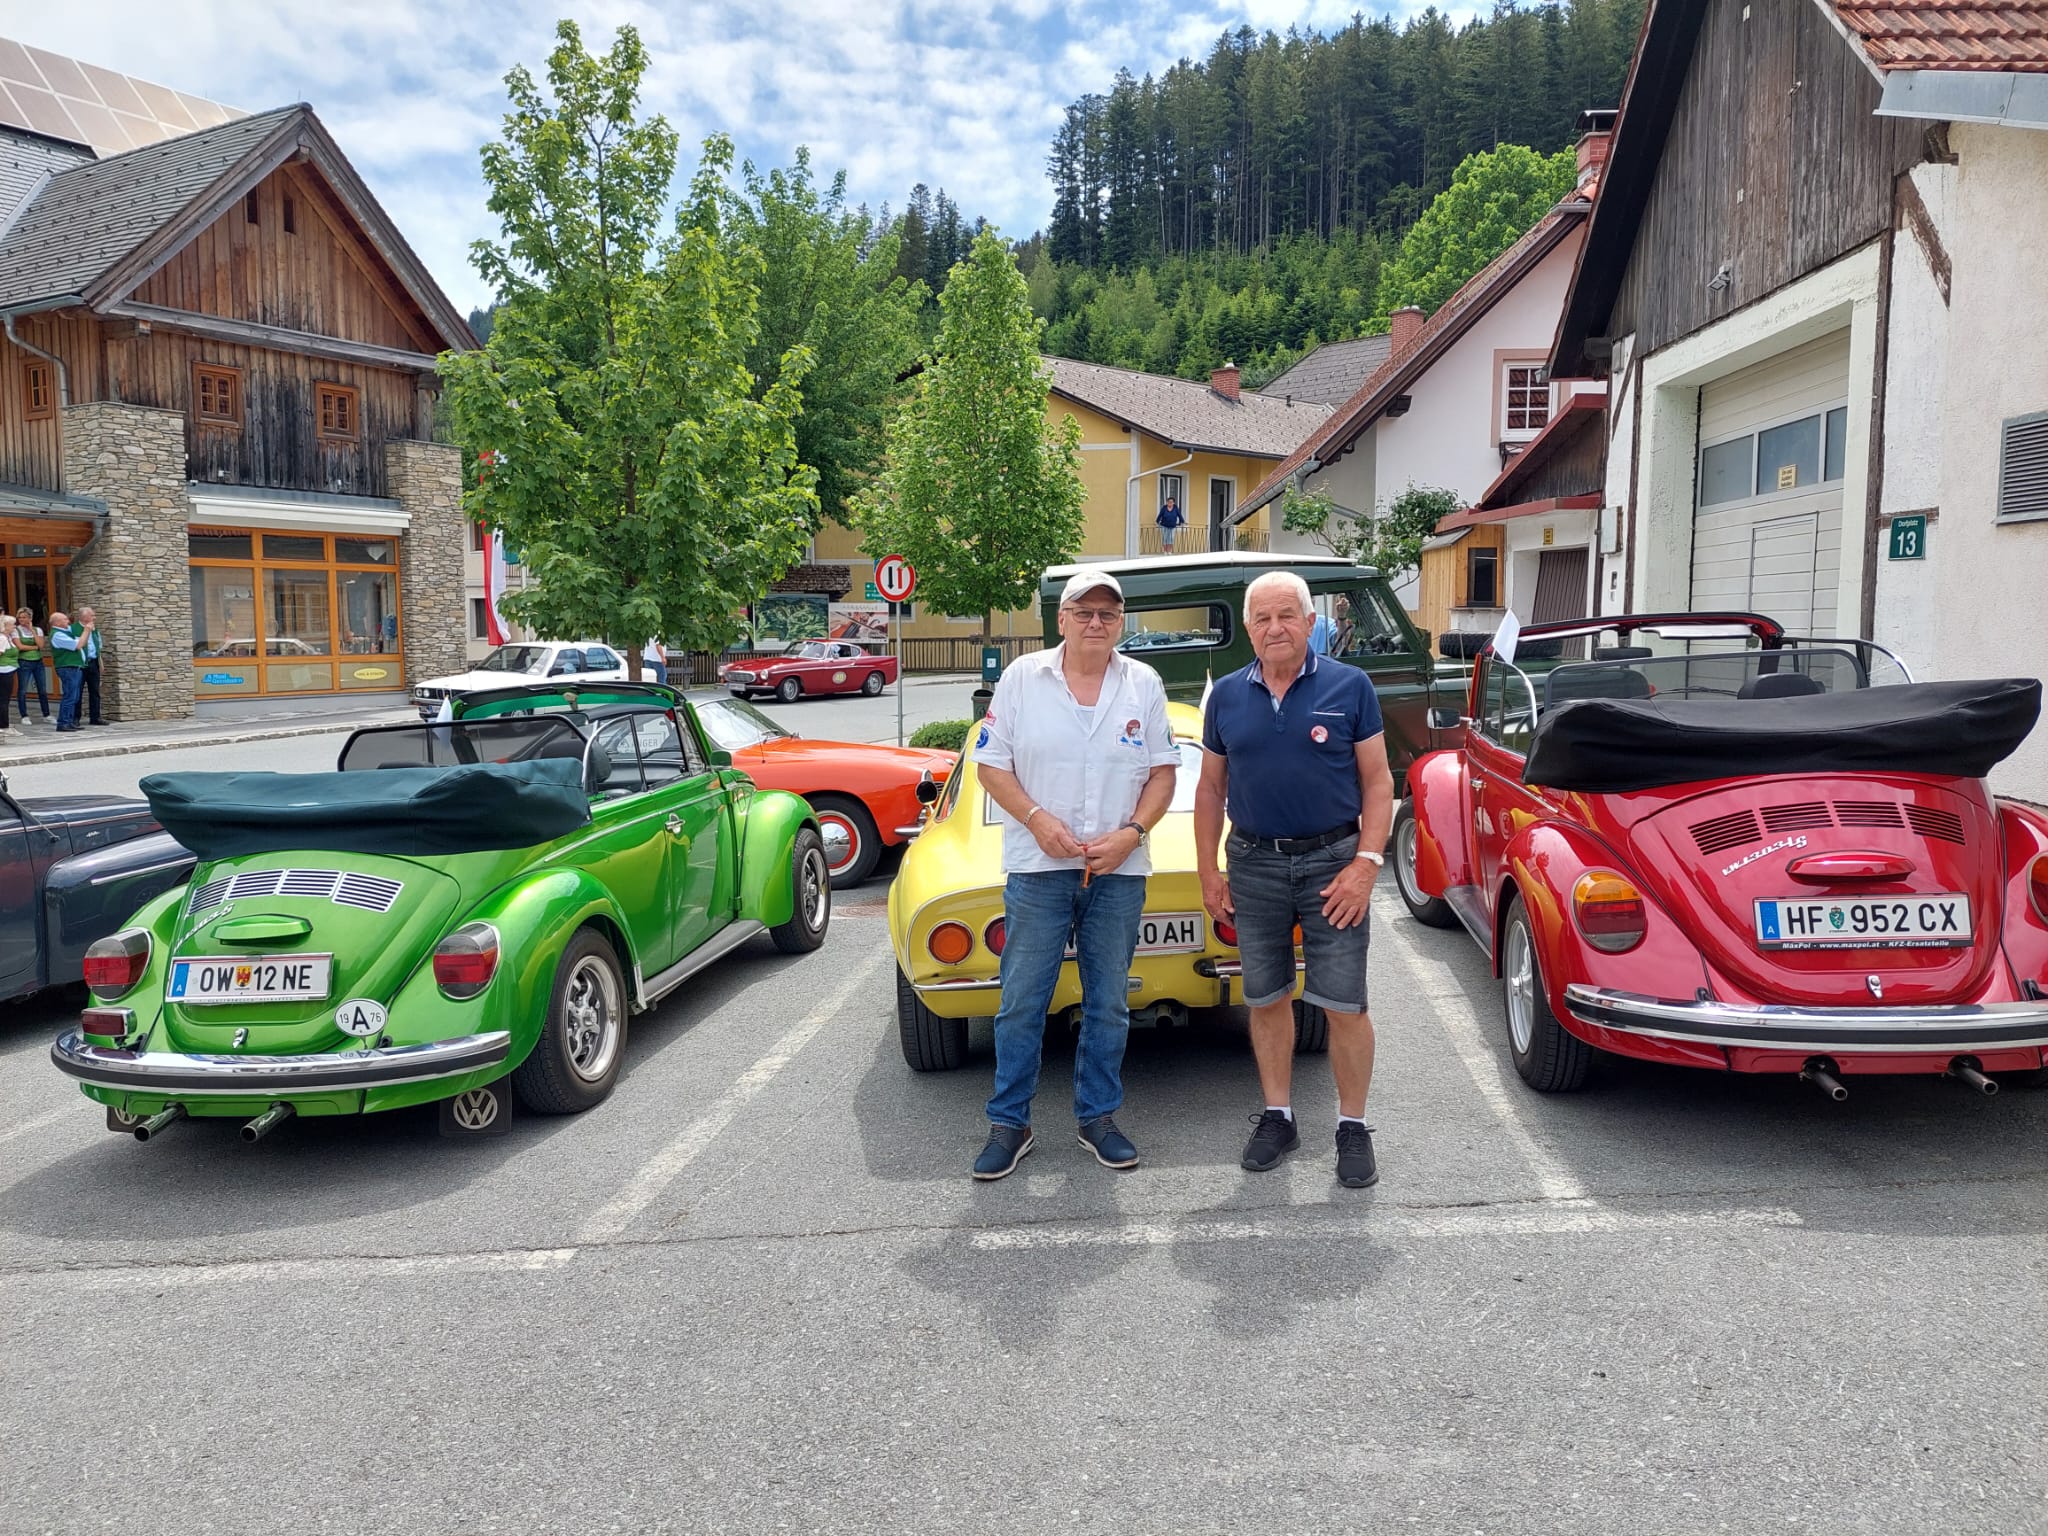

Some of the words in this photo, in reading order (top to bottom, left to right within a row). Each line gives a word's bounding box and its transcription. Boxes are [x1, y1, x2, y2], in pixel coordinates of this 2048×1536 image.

[1897, 531, 1917, 556] 13
[1786, 906, 1824, 934] HF
[1850, 904, 1911, 933] 952
[1918, 902, 1957, 932] CX
[1163, 920, 1195, 944] AH
[1767, 926, 1776, 935] A
[1819, 941, 1880, 949] www.maxpol.at
[176, 984, 183, 992] A
[200, 966, 235, 993] OW
[253, 965, 278, 991] 12
[283, 964, 314, 990] NE
[339, 1013, 350, 1024] 19
[352, 1006, 370, 1030] A
[370, 1012, 382, 1023] 76
